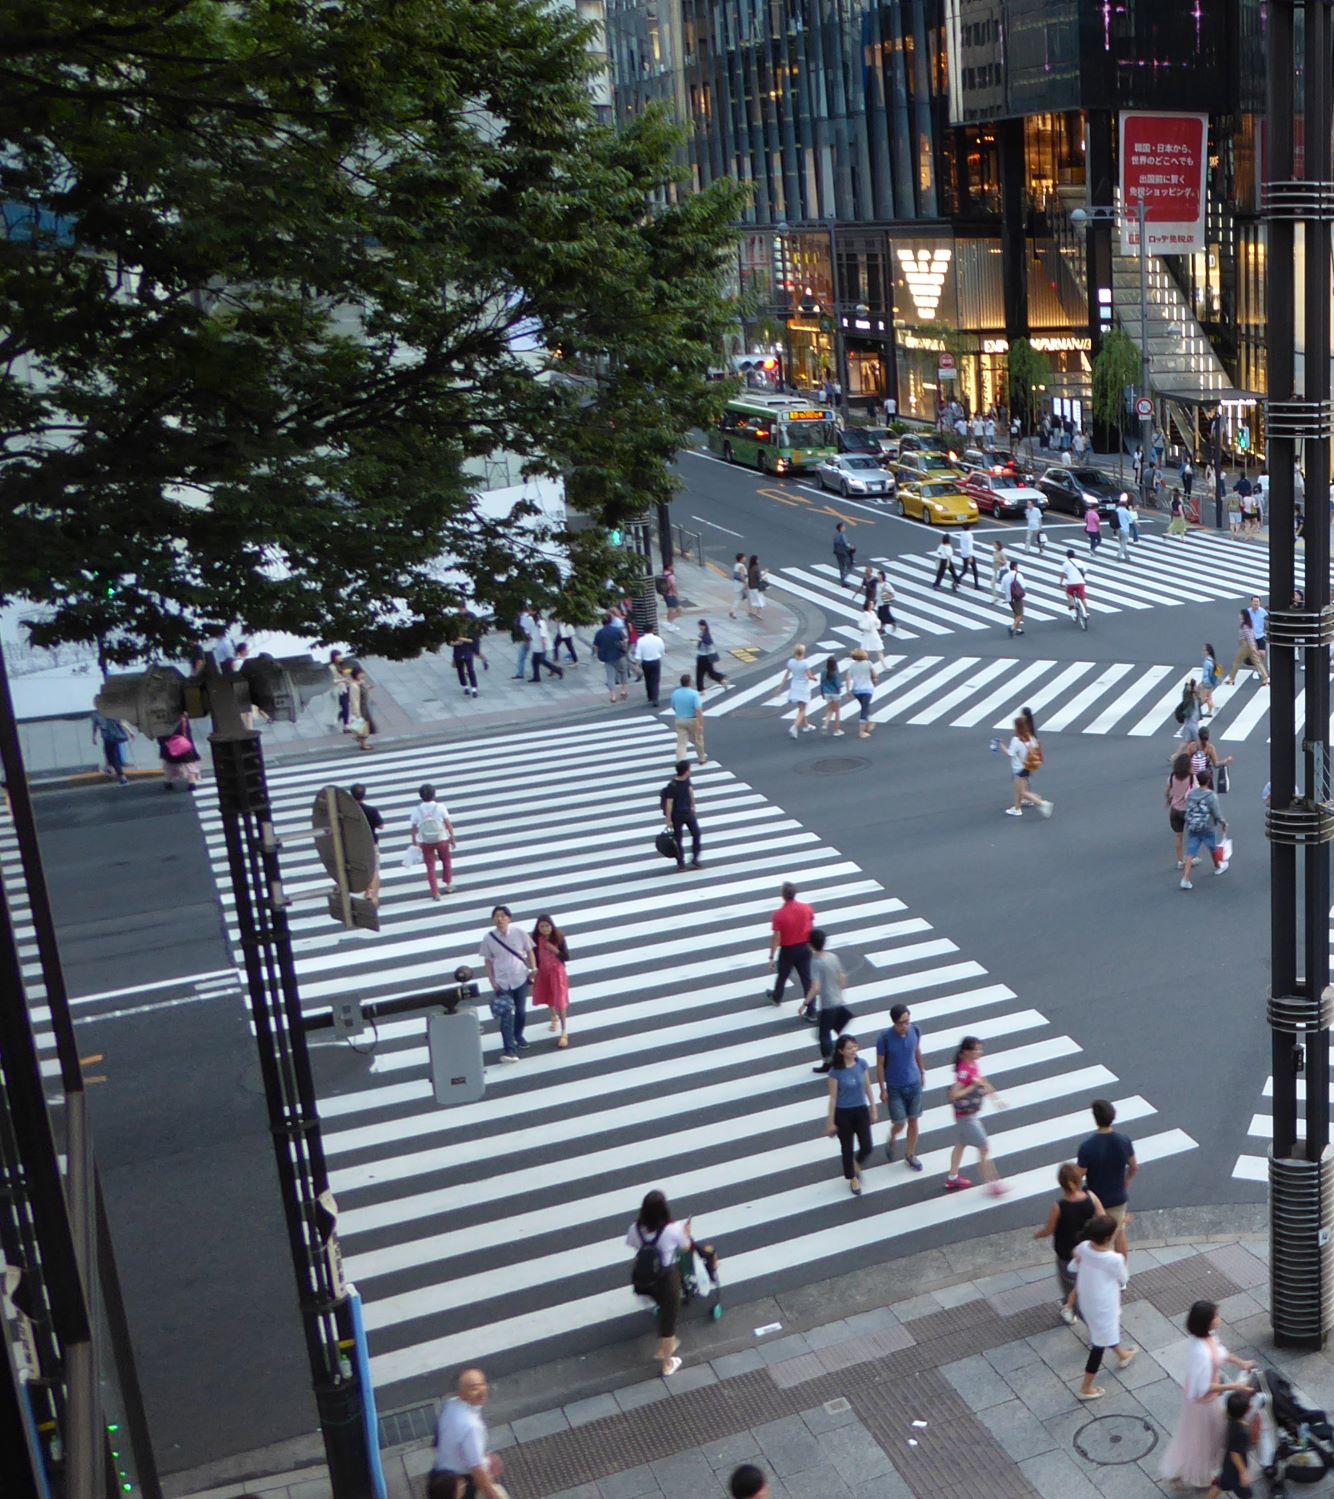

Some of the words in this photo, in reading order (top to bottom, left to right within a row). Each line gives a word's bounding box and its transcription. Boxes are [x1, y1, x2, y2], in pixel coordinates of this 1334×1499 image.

[1131, 155, 1194, 166] 世界のどこへでも
